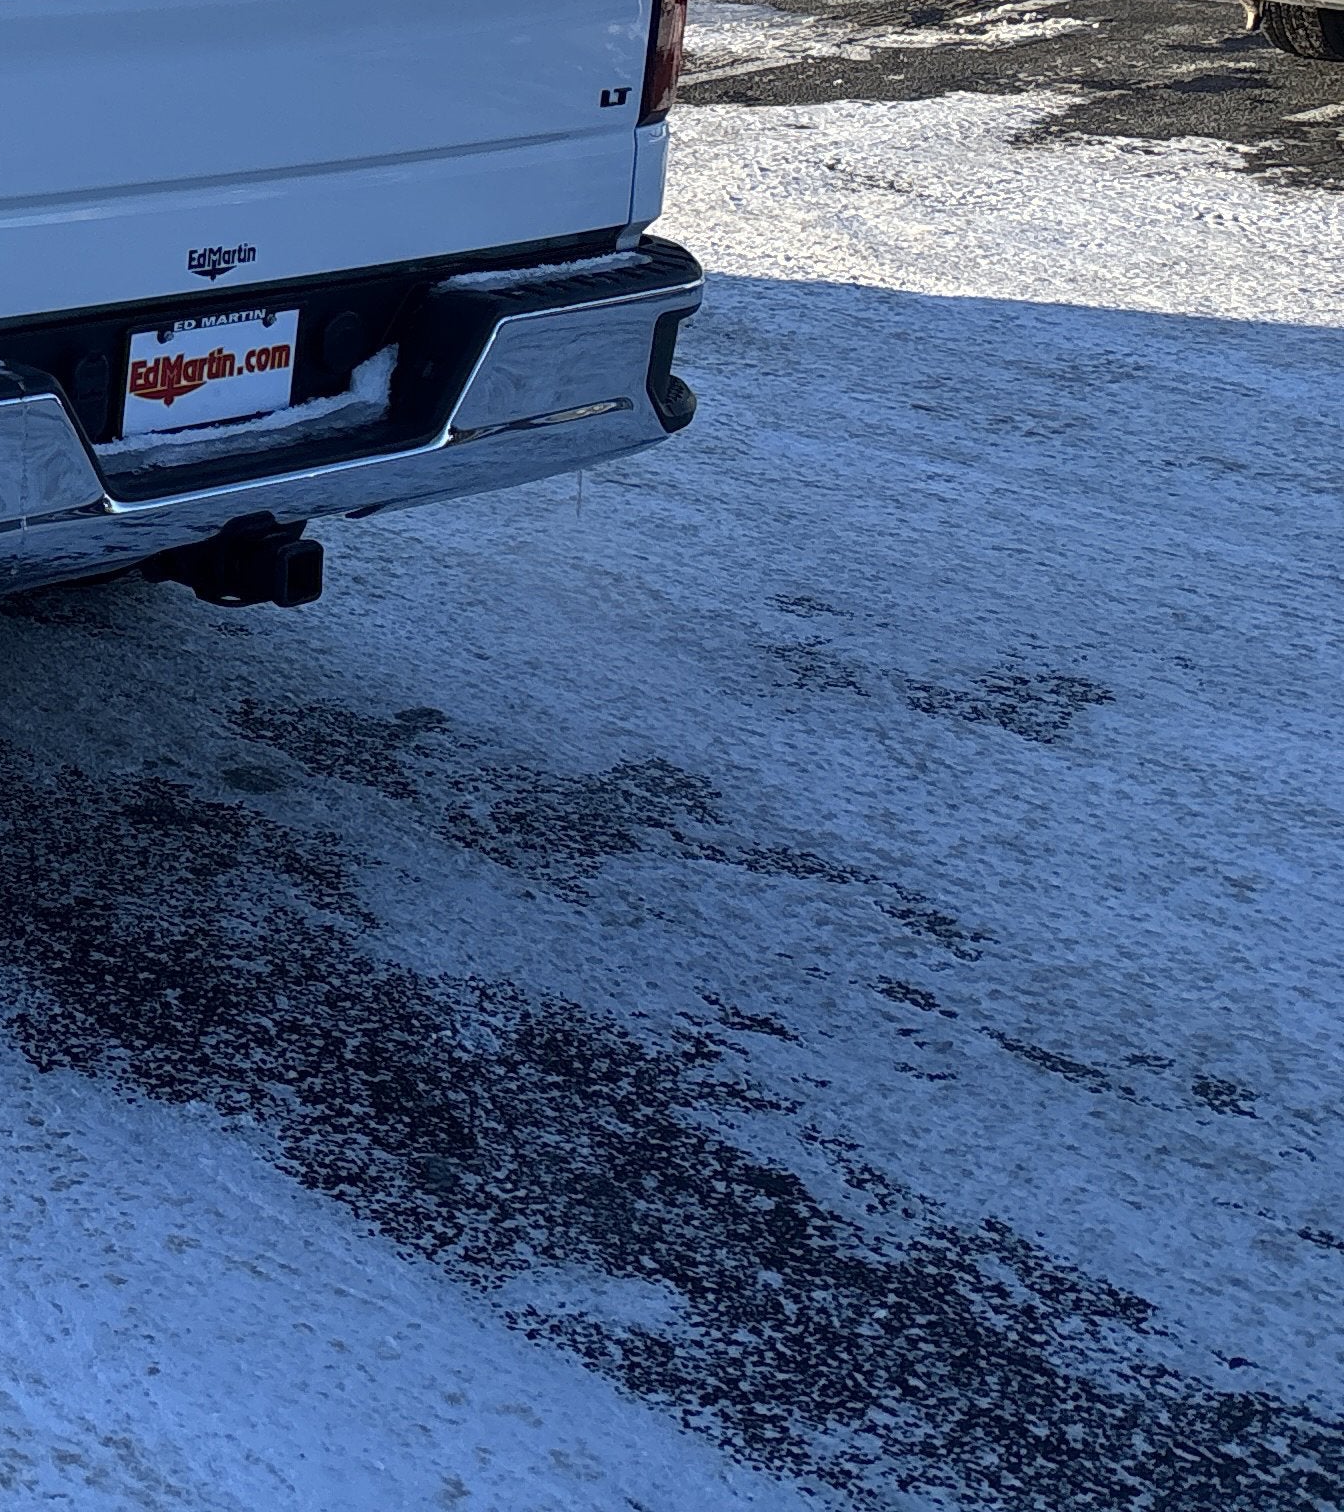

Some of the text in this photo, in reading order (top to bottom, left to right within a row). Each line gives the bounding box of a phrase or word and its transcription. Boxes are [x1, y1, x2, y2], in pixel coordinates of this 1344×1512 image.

[600, 88, 631, 107] LT
[173, 309, 267, 332] ED MARTIN
